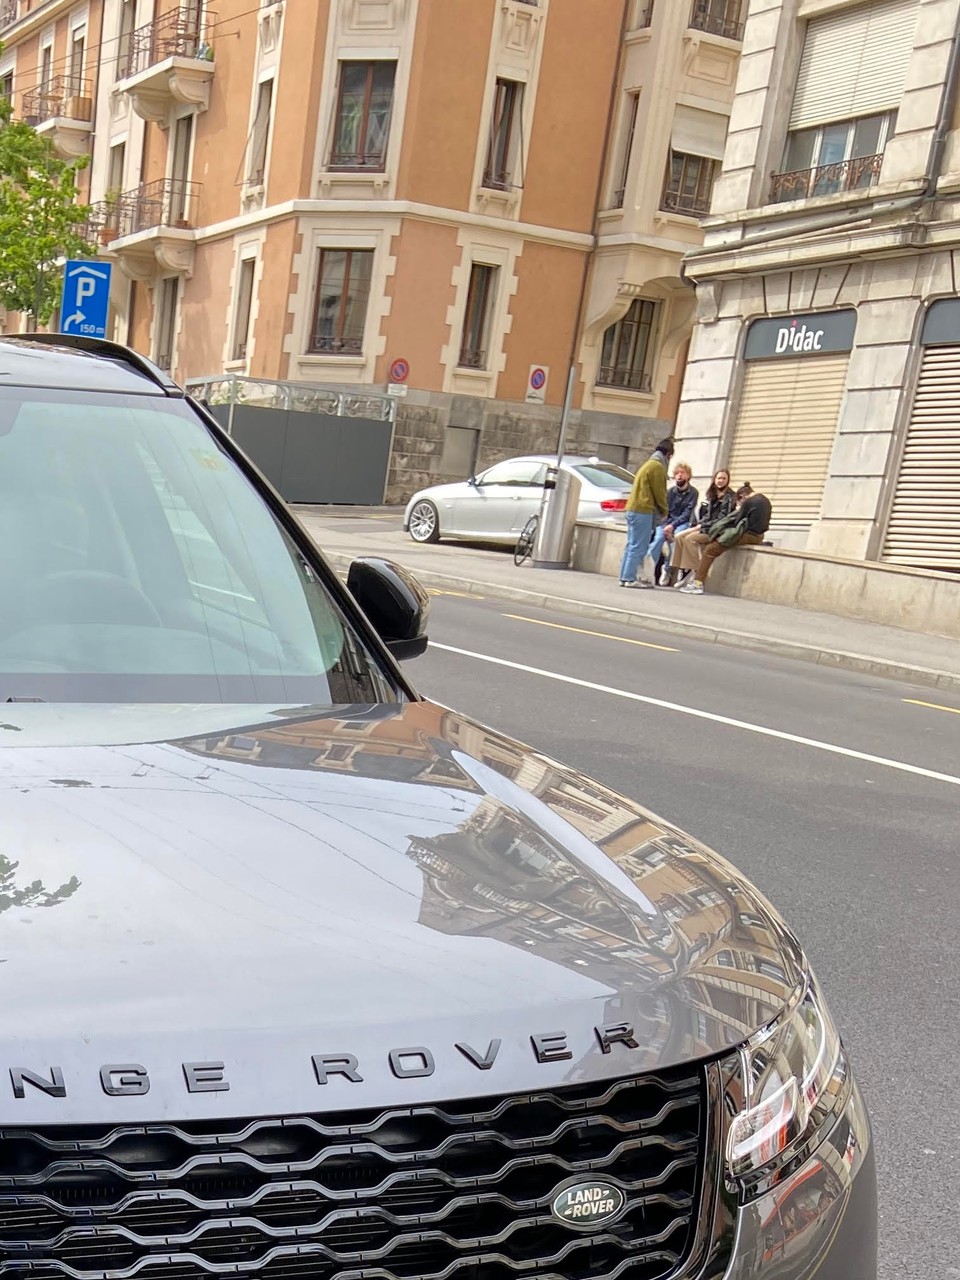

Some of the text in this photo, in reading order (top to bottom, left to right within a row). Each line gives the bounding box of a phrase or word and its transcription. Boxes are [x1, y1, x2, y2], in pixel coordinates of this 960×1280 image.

[76, 277, 96, 307] P
[80, 324, 95, 334] 150
[775, 320, 824, 353] Didac
[311, 1022, 639, 1086] ROVER
[568, 1188, 601, 1205] LAND
[573, 1199, 614, 1217] ROVER
